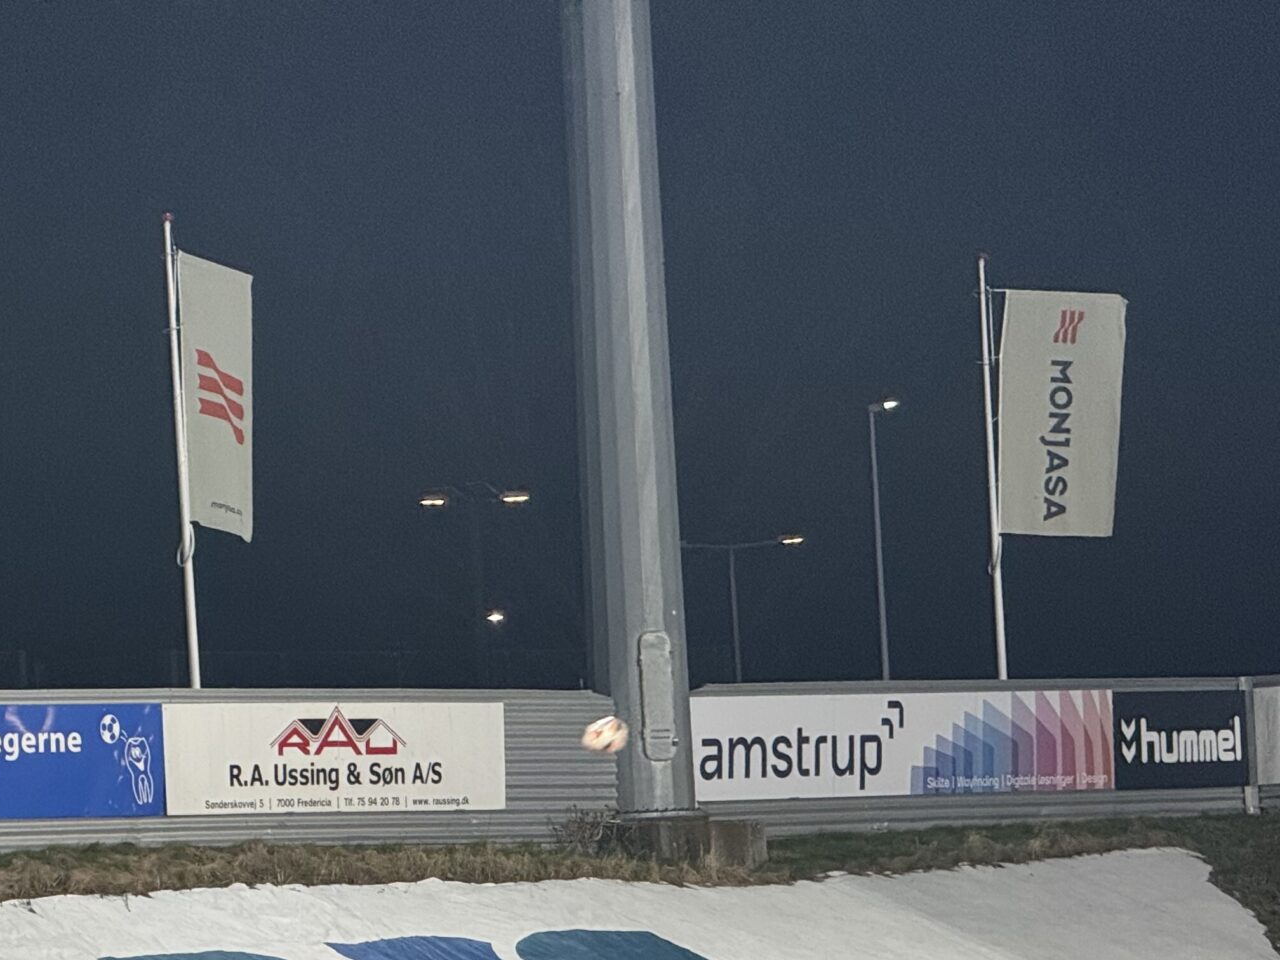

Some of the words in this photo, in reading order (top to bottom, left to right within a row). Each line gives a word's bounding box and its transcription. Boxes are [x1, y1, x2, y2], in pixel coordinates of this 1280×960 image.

[1039, 360, 1074, 521] MONJASA
[1139, 716, 1242, 763] hummel
[229, 763, 270, 788] R.A.
[273, 762, 340, 791] Ussing
[346, 763, 363, 786] &
[369, 762, 406, 786] Søn
[411, 761, 443, 786] A/S
[259, 798, 265, 808] 5
[277, 798, 295, 808] 7000
[297, 797, 332, 808] Fredericia
[357, 797, 366, 807] 75
[367, 797, 377, 807] 94
[380, 797, 389, 807] 20
[391, 796, 401, 806] 78
